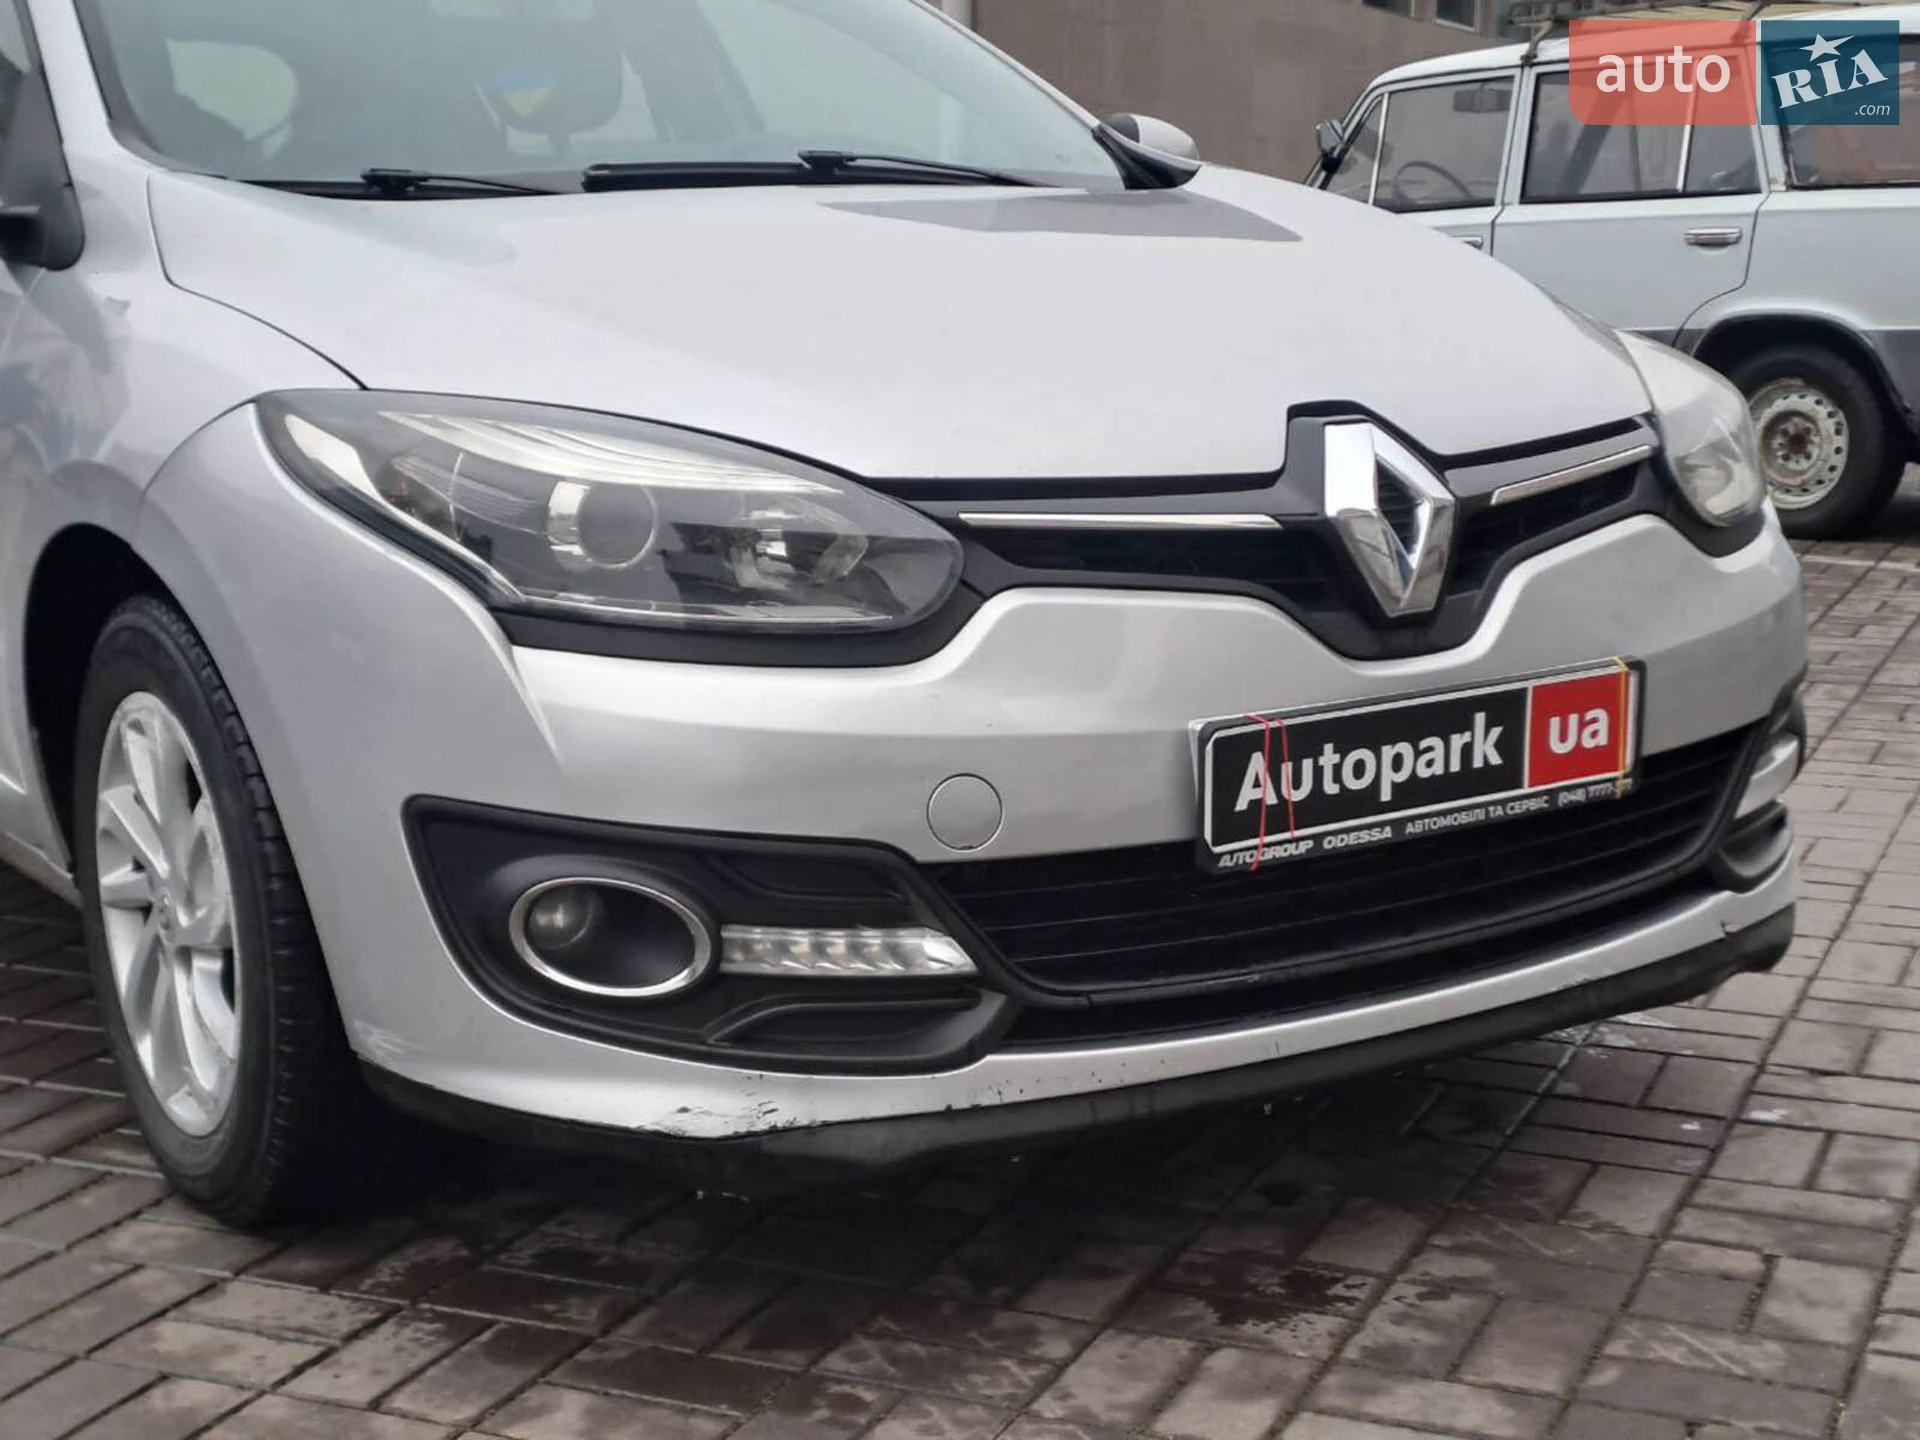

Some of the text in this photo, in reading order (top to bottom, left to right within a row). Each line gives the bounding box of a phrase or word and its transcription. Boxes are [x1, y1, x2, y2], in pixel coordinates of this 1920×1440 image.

[1234, 708, 1608, 811] Autopark ua
[1405, 808, 1486, 834] АВТОМОБІЛІ
[1488, 806, 1504, 818] ТА
[1506, 796, 1549, 815] СЕРВІС
[1218, 826, 1392, 867] AUTOGROUP ODESSA
